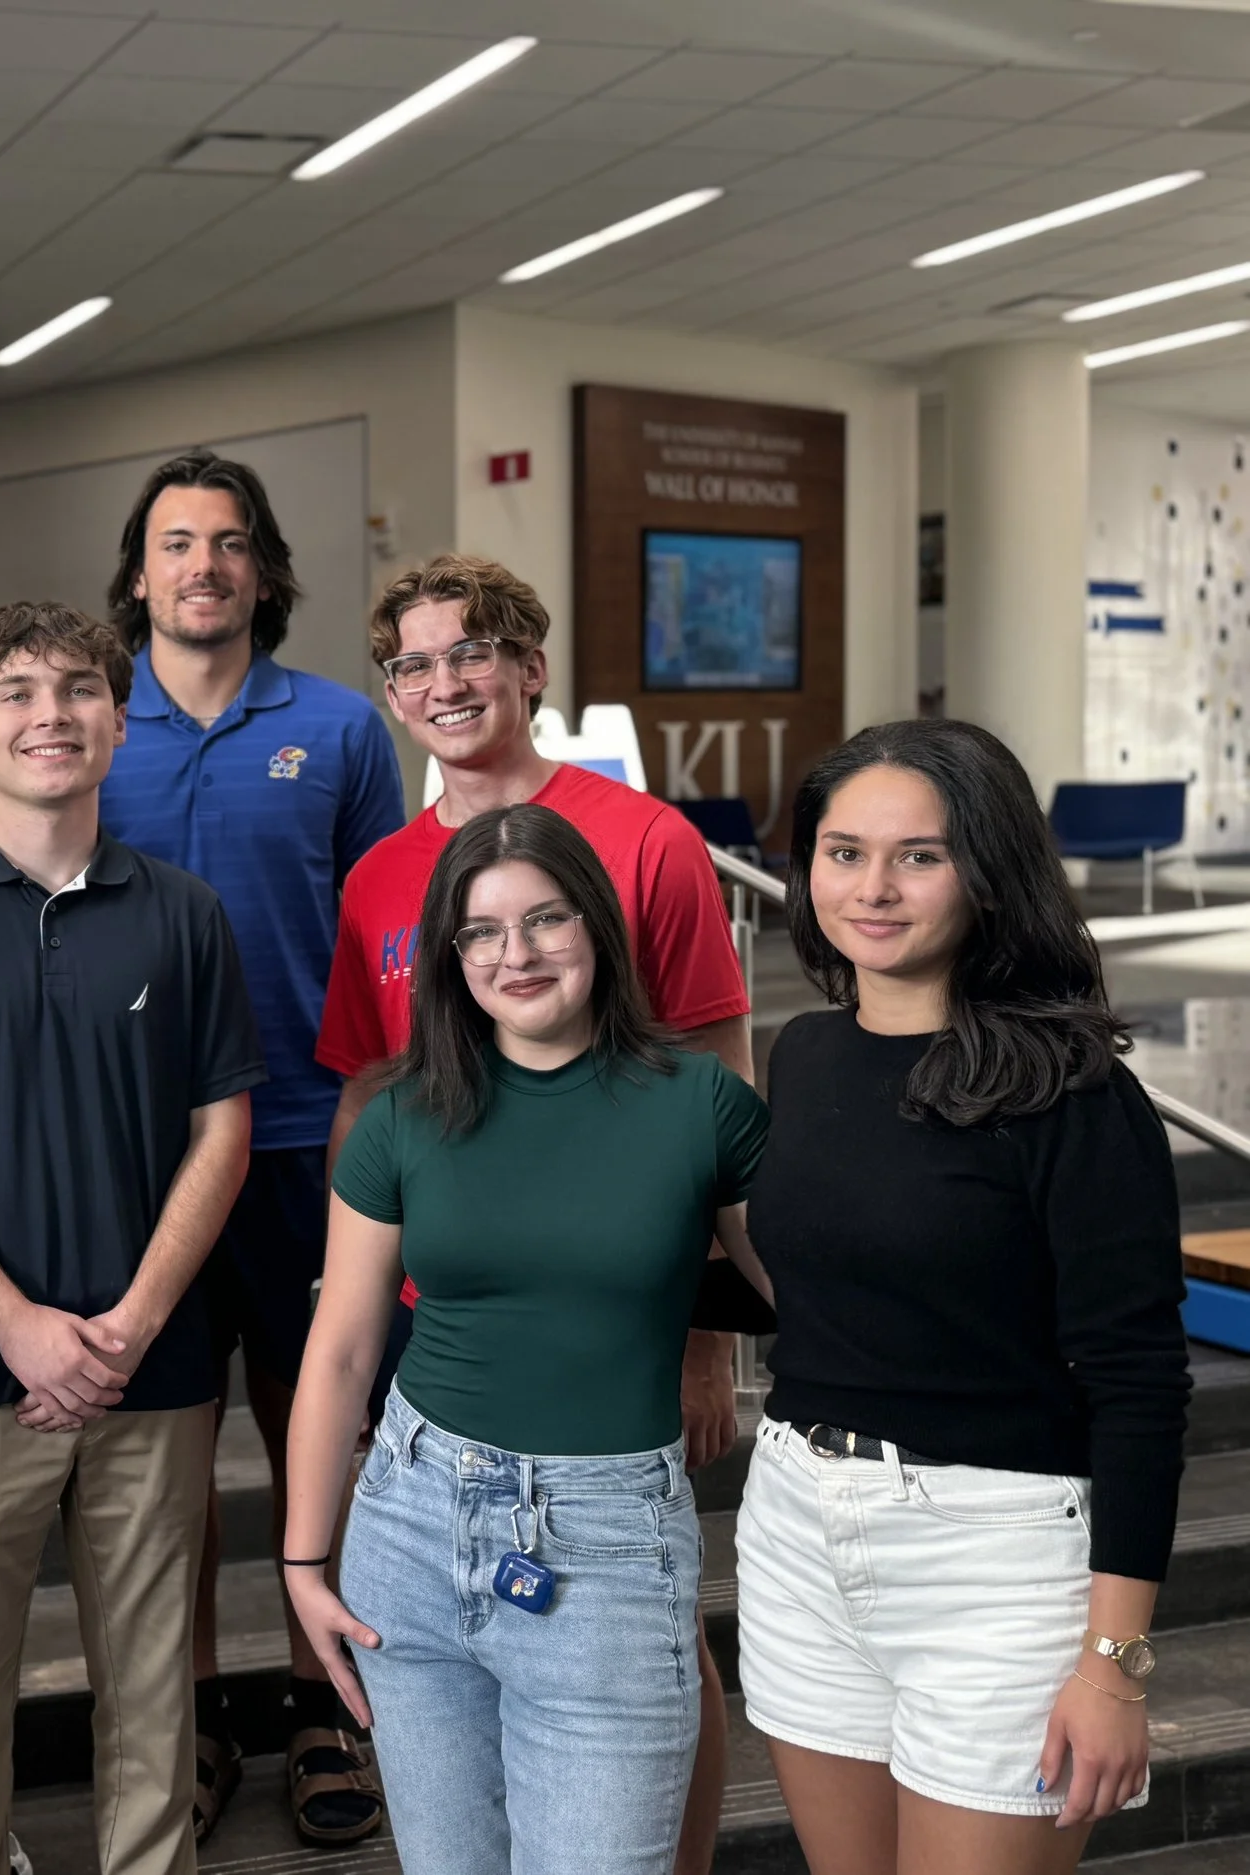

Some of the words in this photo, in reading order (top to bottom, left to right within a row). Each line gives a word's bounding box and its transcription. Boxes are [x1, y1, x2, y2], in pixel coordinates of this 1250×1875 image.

[644, 470, 698, 500] WALL
[699, 474, 725, 503] OF
[728, 477, 799, 507] HONOR
[657, 718, 789, 838] KU
